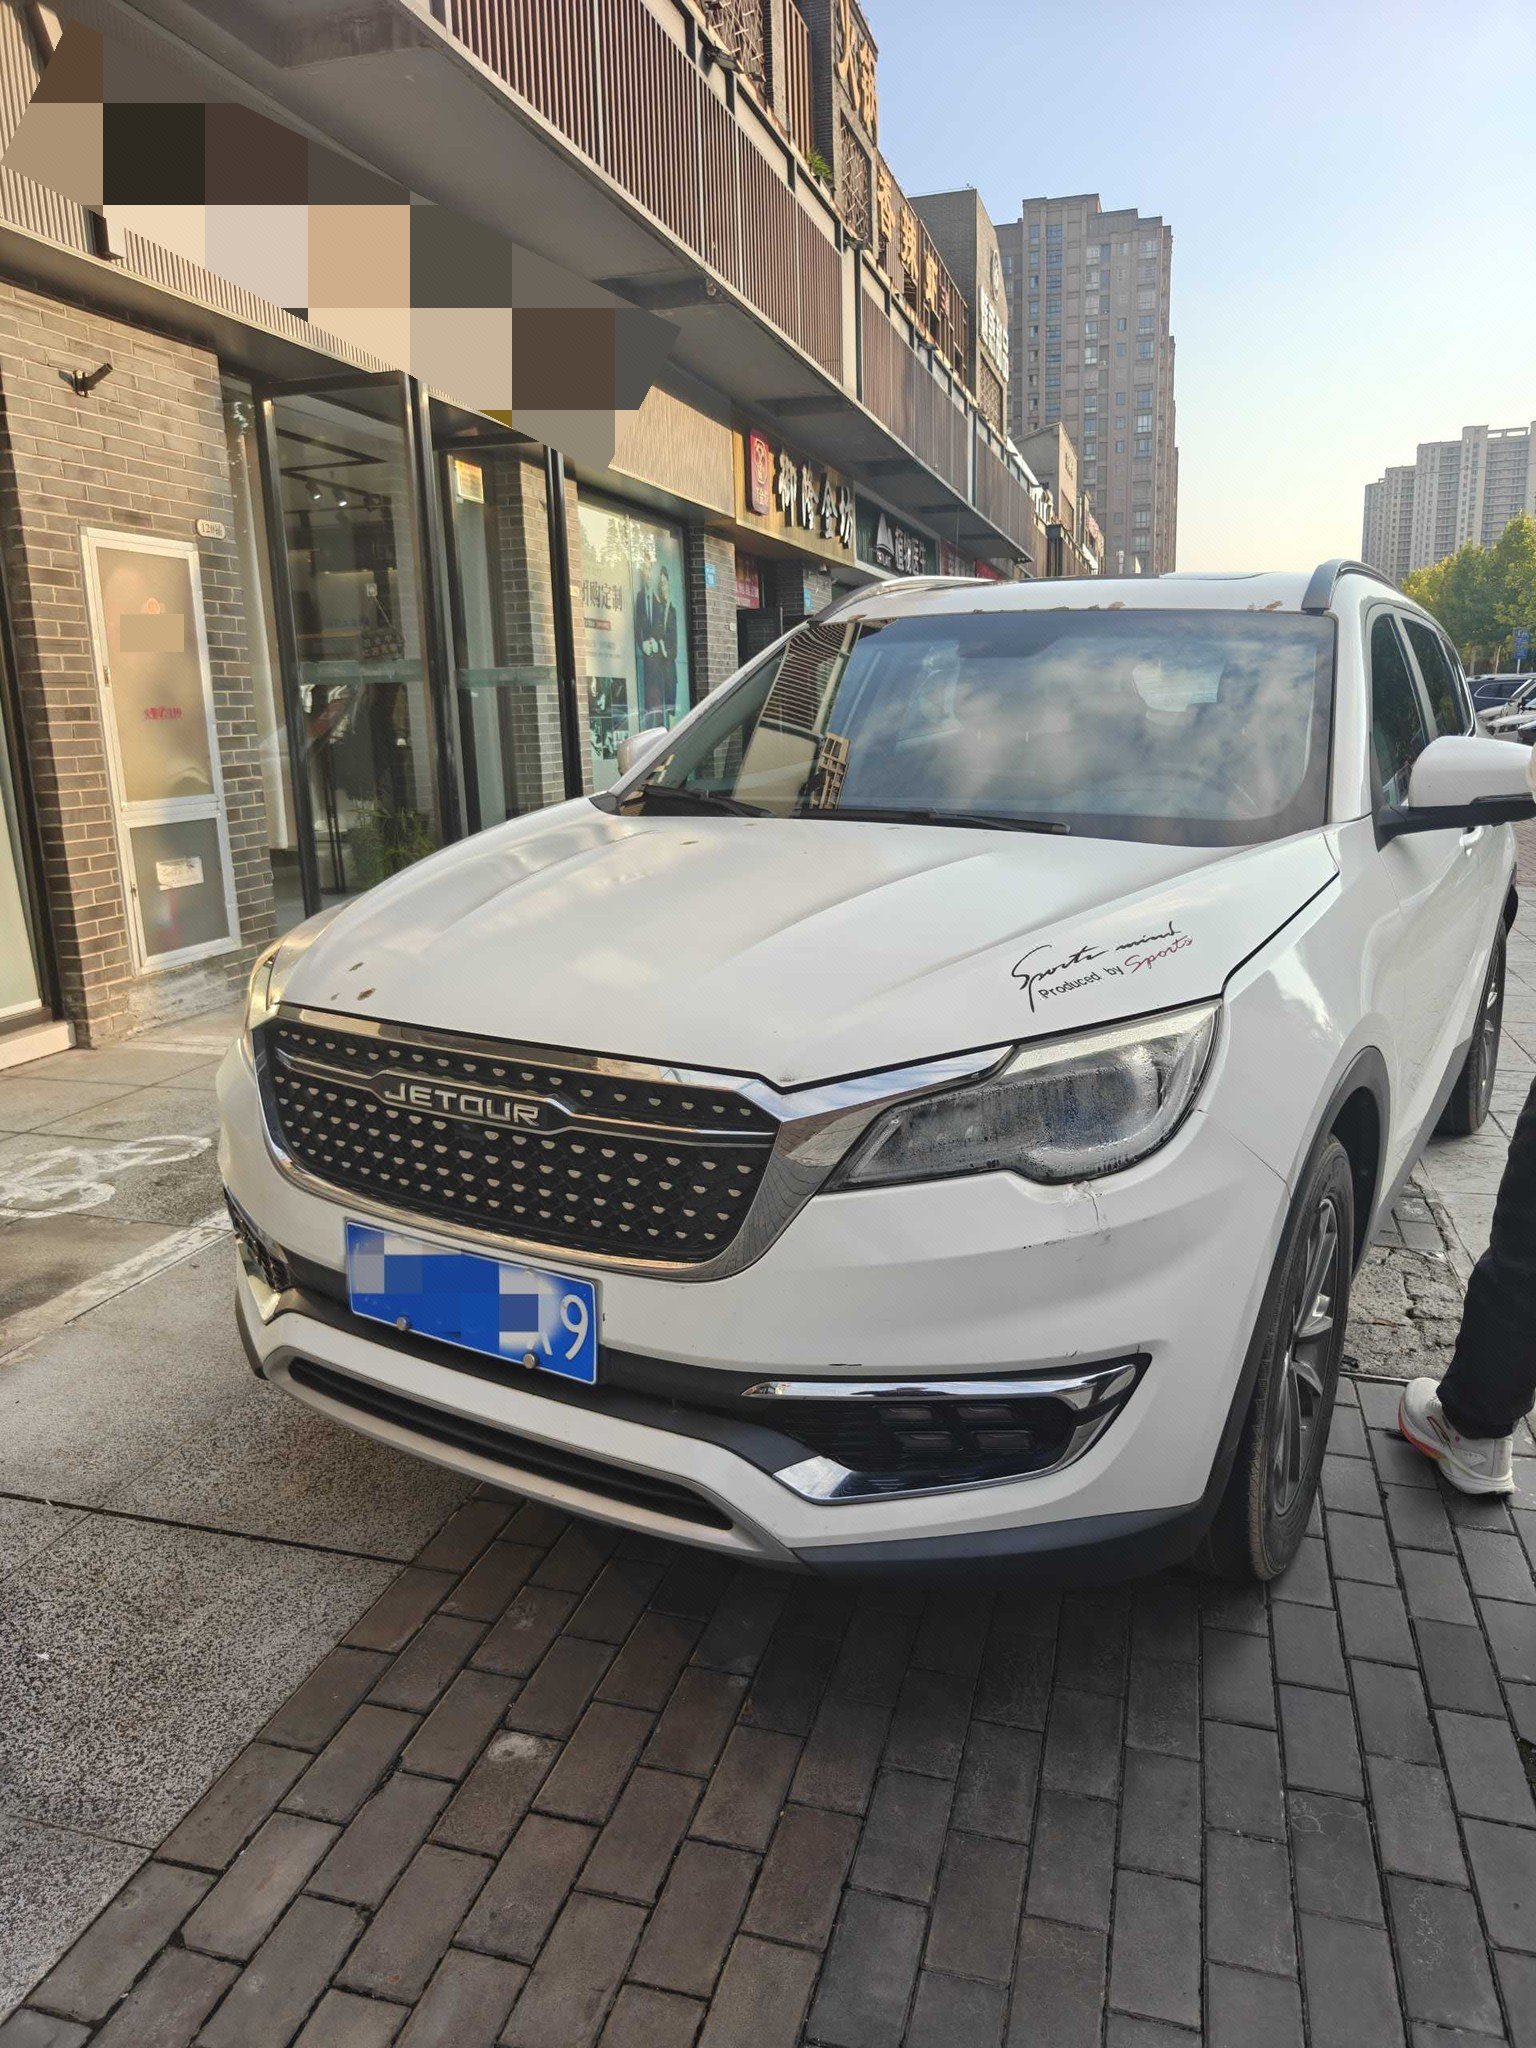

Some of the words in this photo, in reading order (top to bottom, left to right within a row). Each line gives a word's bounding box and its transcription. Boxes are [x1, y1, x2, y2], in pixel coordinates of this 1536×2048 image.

[1115, 921, 1181, 951] mind
[1038, 972, 1101, 999] Produced
[1105, 965, 1125, 976] by
[1124, 935, 1193, 974] Sports
[384, 1082, 540, 1127] JETOUR
